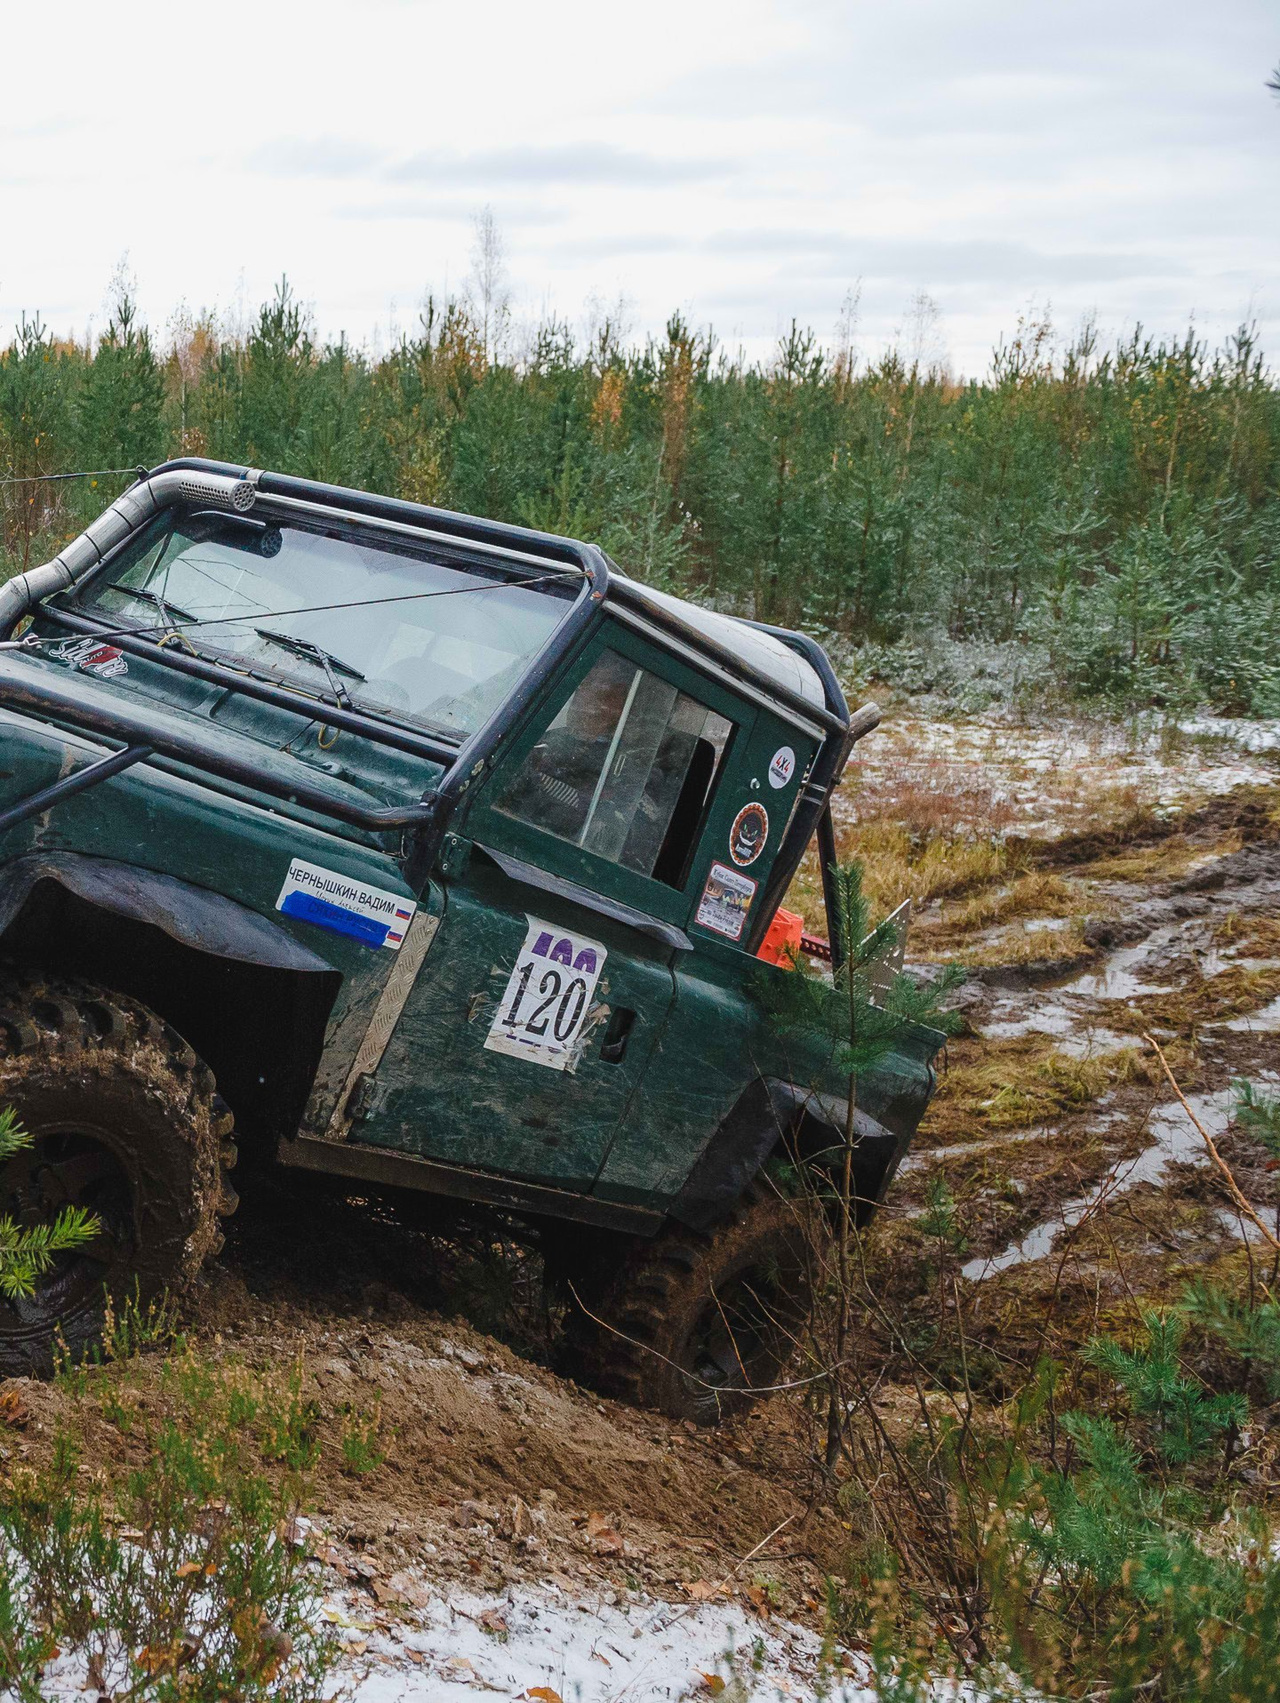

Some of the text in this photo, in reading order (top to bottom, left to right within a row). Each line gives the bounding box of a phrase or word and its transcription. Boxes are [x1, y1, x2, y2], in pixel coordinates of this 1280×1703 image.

[289, 866, 358, 901] ЧЕРНЫШКИН
[358, 892, 396, 915] ВАДИМ
[501, 962, 587, 1042] 120
